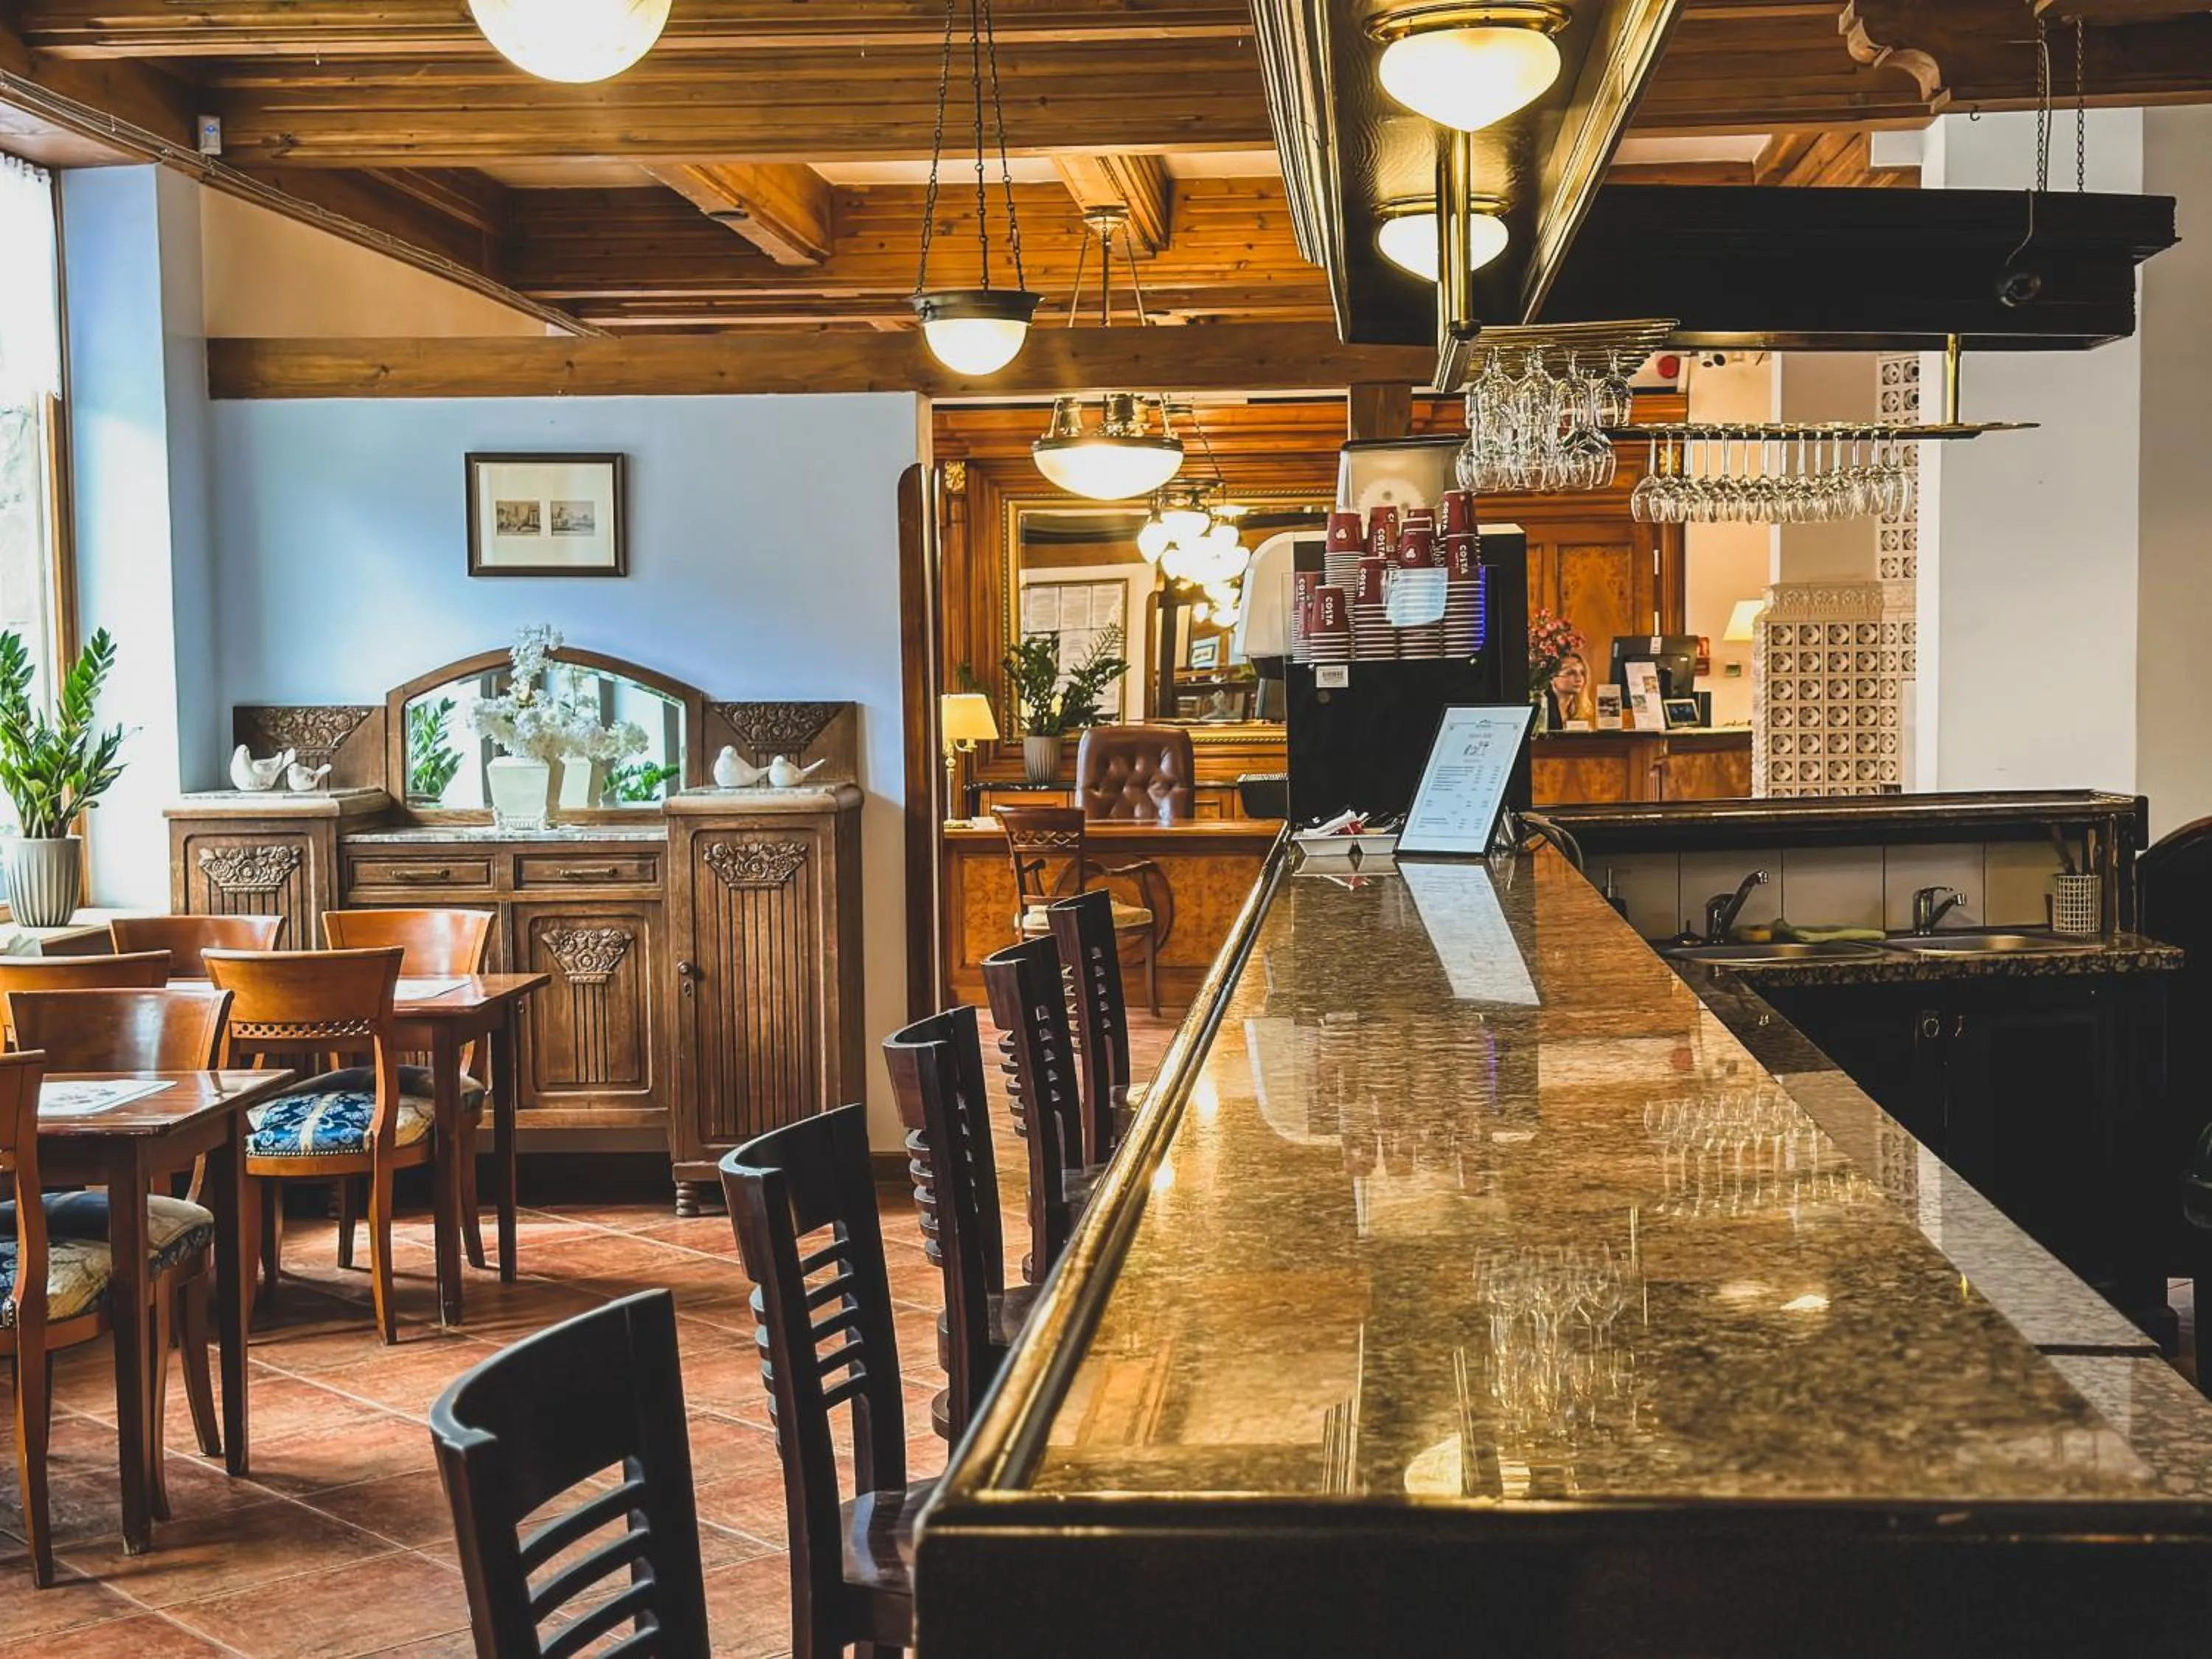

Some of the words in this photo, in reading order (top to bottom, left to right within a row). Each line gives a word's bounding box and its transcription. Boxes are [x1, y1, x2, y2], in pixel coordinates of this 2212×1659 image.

[1377, 528, 1385, 558] COSTA
[1459, 545, 1468, 574] COSTA
[1358, 567, 1366, 598] COSTA
[1325, 596, 1334, 626] COSTA
